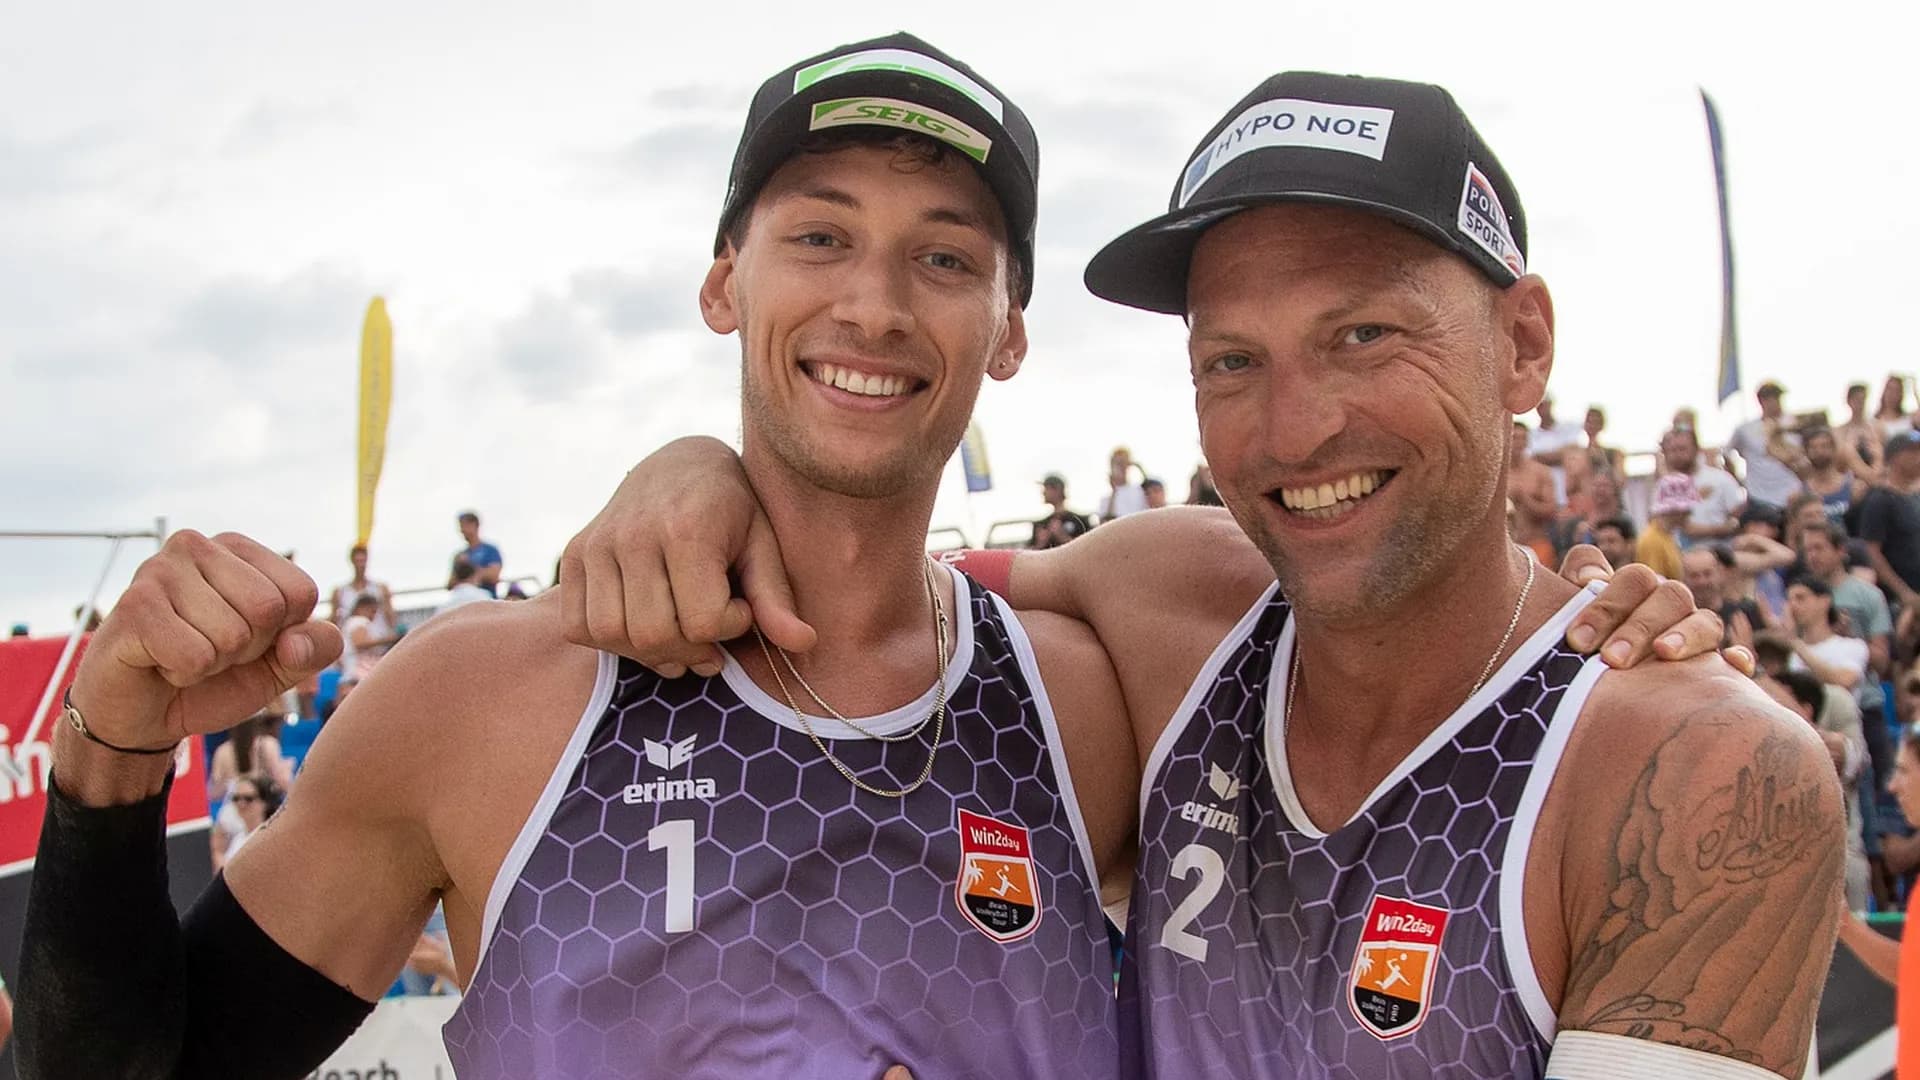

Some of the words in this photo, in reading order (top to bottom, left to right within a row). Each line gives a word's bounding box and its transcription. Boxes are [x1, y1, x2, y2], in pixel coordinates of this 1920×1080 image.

[1215, 112, 1295, 158] HYPO
[1307, 115, 1379, 141] NOE
[1466, 212, 1506, 256] SPORT
[623, 776, 716, 804] erima
[969, 825, 1020, 851] Win2day
[648, 819, 695, 933] 1
[1160, 843, 1225, 963] 2
[308, 1060, 399, 1080] each
